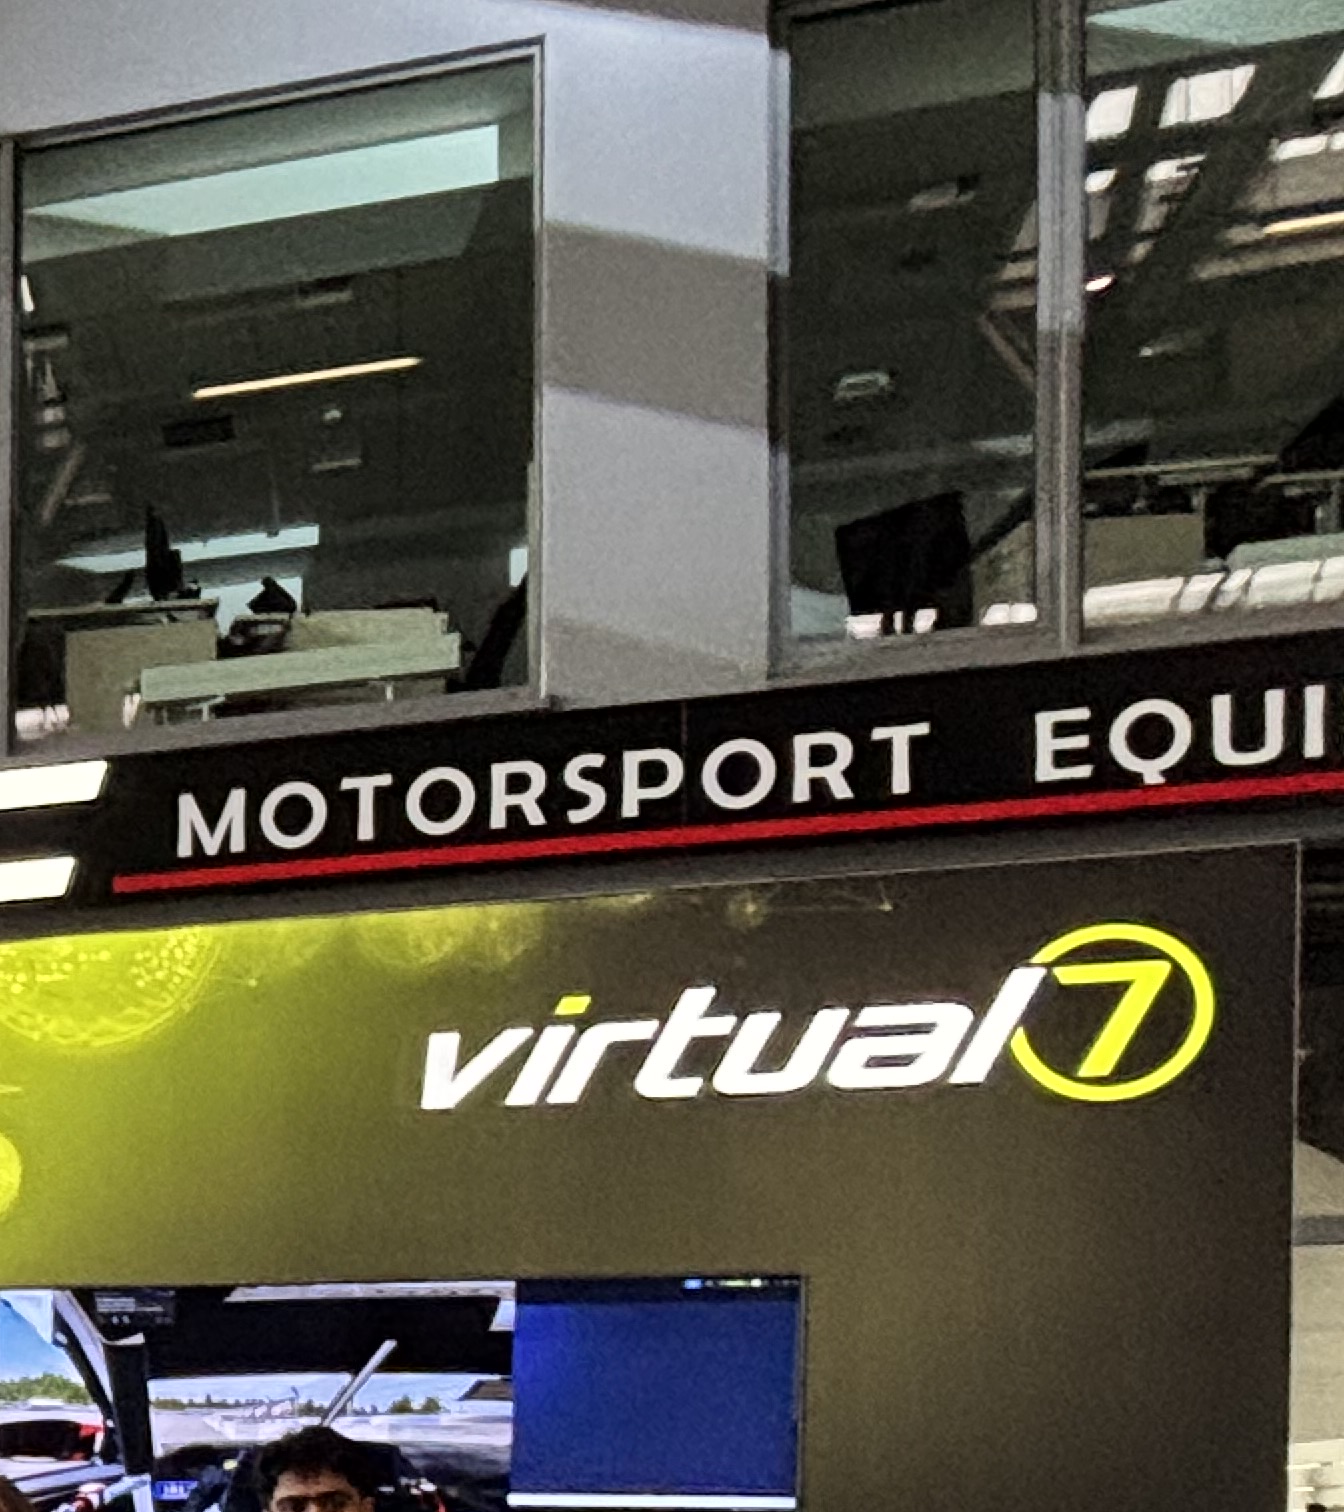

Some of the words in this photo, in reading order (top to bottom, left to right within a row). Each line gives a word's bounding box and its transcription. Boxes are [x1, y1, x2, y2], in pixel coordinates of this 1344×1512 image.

[176, 723, 931, 857] MOTORSPORT
[1033, 684, 1325, 786] EQUI
[419, 923, 1215, 1110] virtual7
